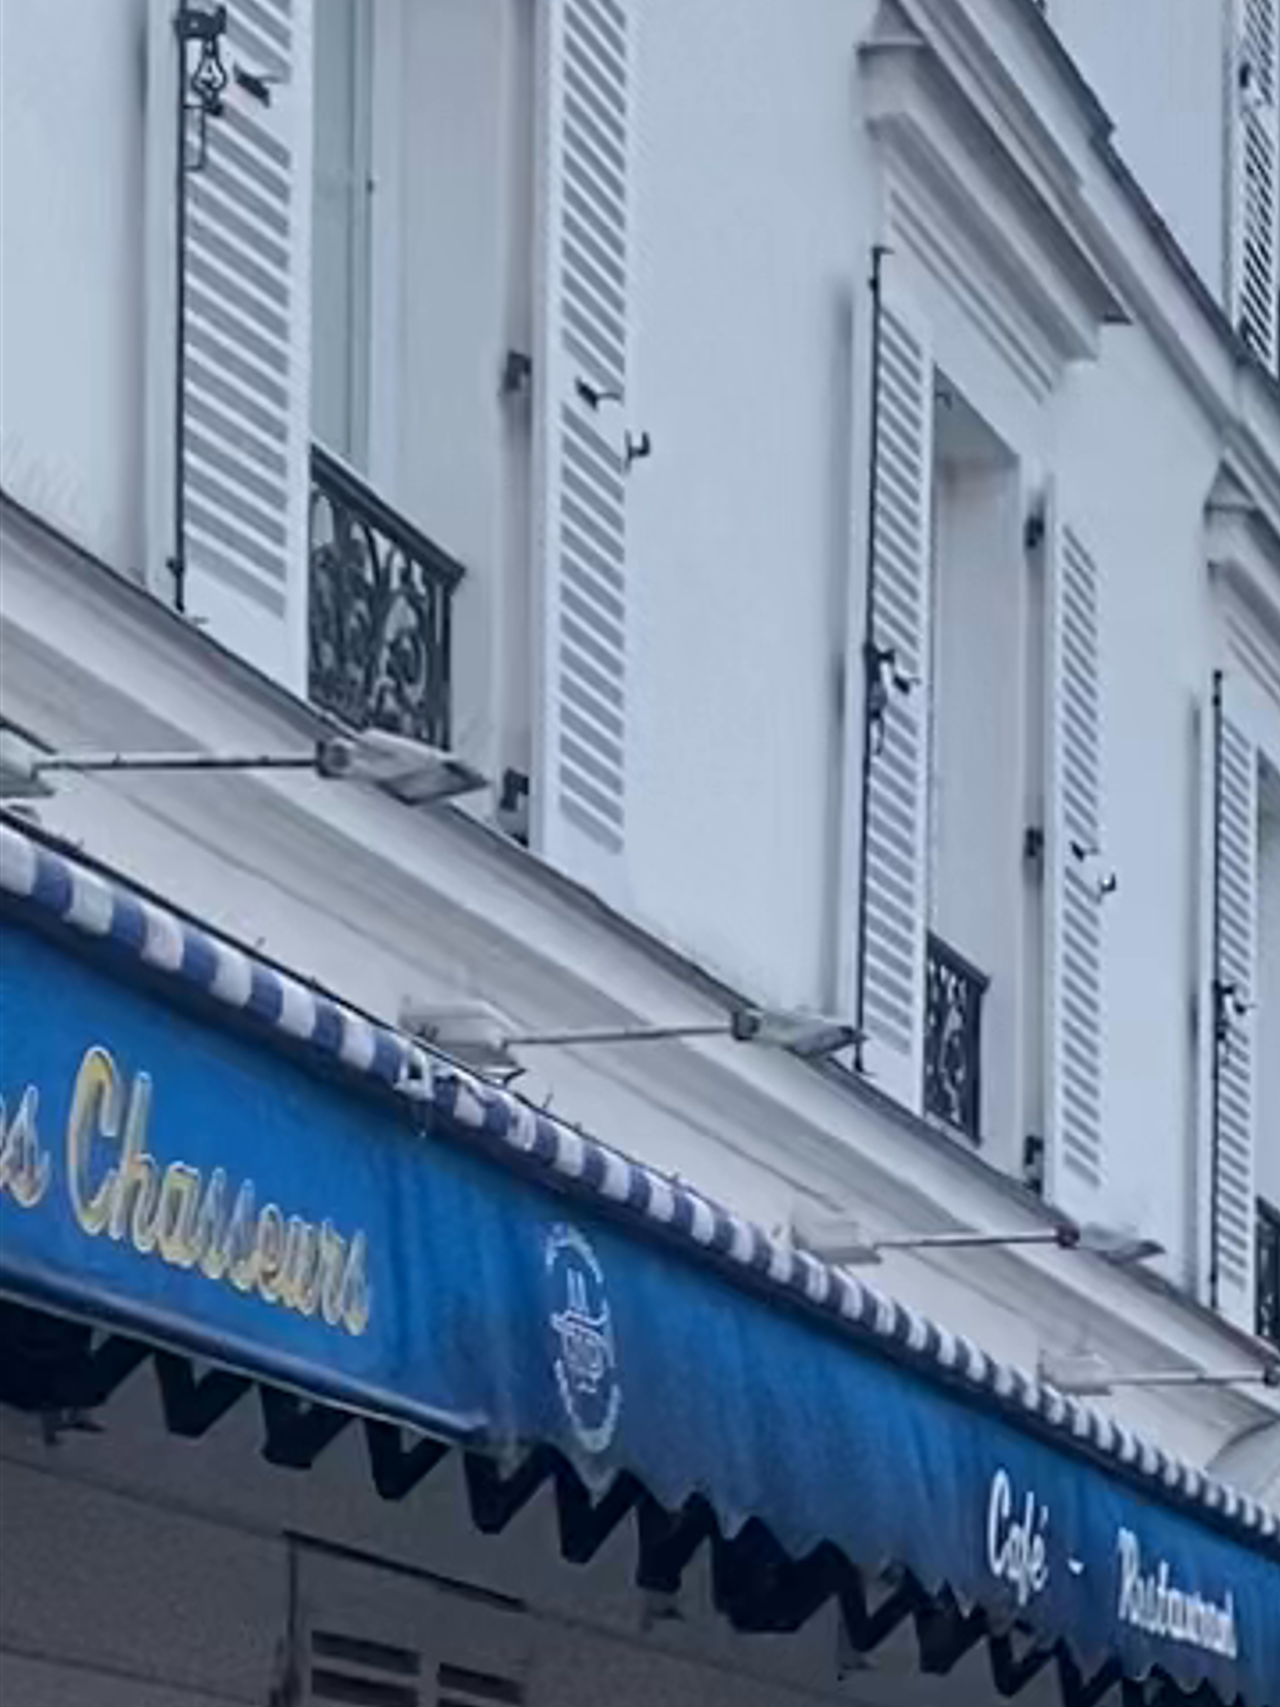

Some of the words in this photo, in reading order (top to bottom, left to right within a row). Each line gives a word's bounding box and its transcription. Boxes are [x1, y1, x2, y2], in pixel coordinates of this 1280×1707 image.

[0, 1084, 51, 1207] s
[67, 1044, 372, 1335] Chasseurs
[987, 1467, 1049, 1606] Café
[1117, 1525, 1237, 1660] Restaurant
